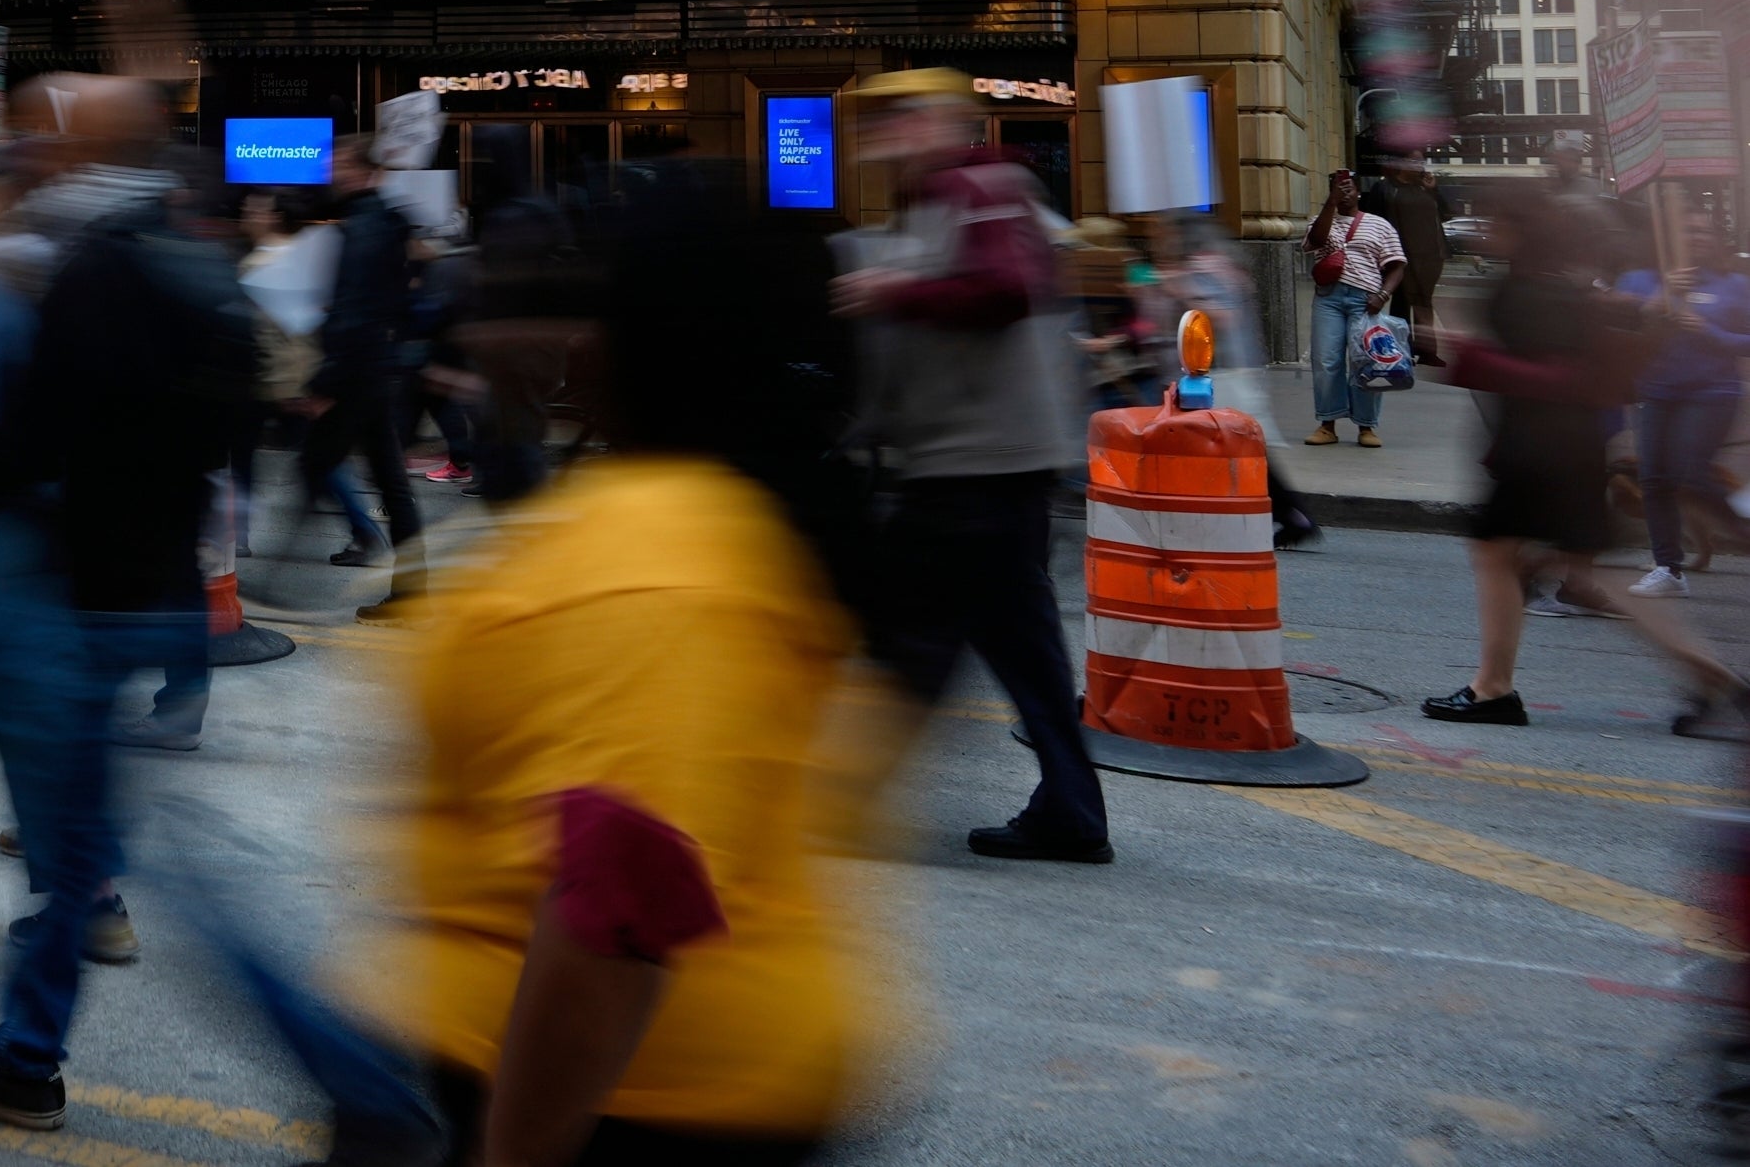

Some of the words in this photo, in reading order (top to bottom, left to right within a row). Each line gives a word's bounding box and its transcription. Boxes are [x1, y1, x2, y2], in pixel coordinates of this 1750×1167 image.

[779, 128, 800, 137] LIVE
[779, 137, 804, 146] ONLY
[236, 143, 322, 159] ticketmaster
[779, 146, 822, 155] HAPPENS
[779, 155, 809, 164] ONCE.
[1162, 693, 1230, 726] TCP
